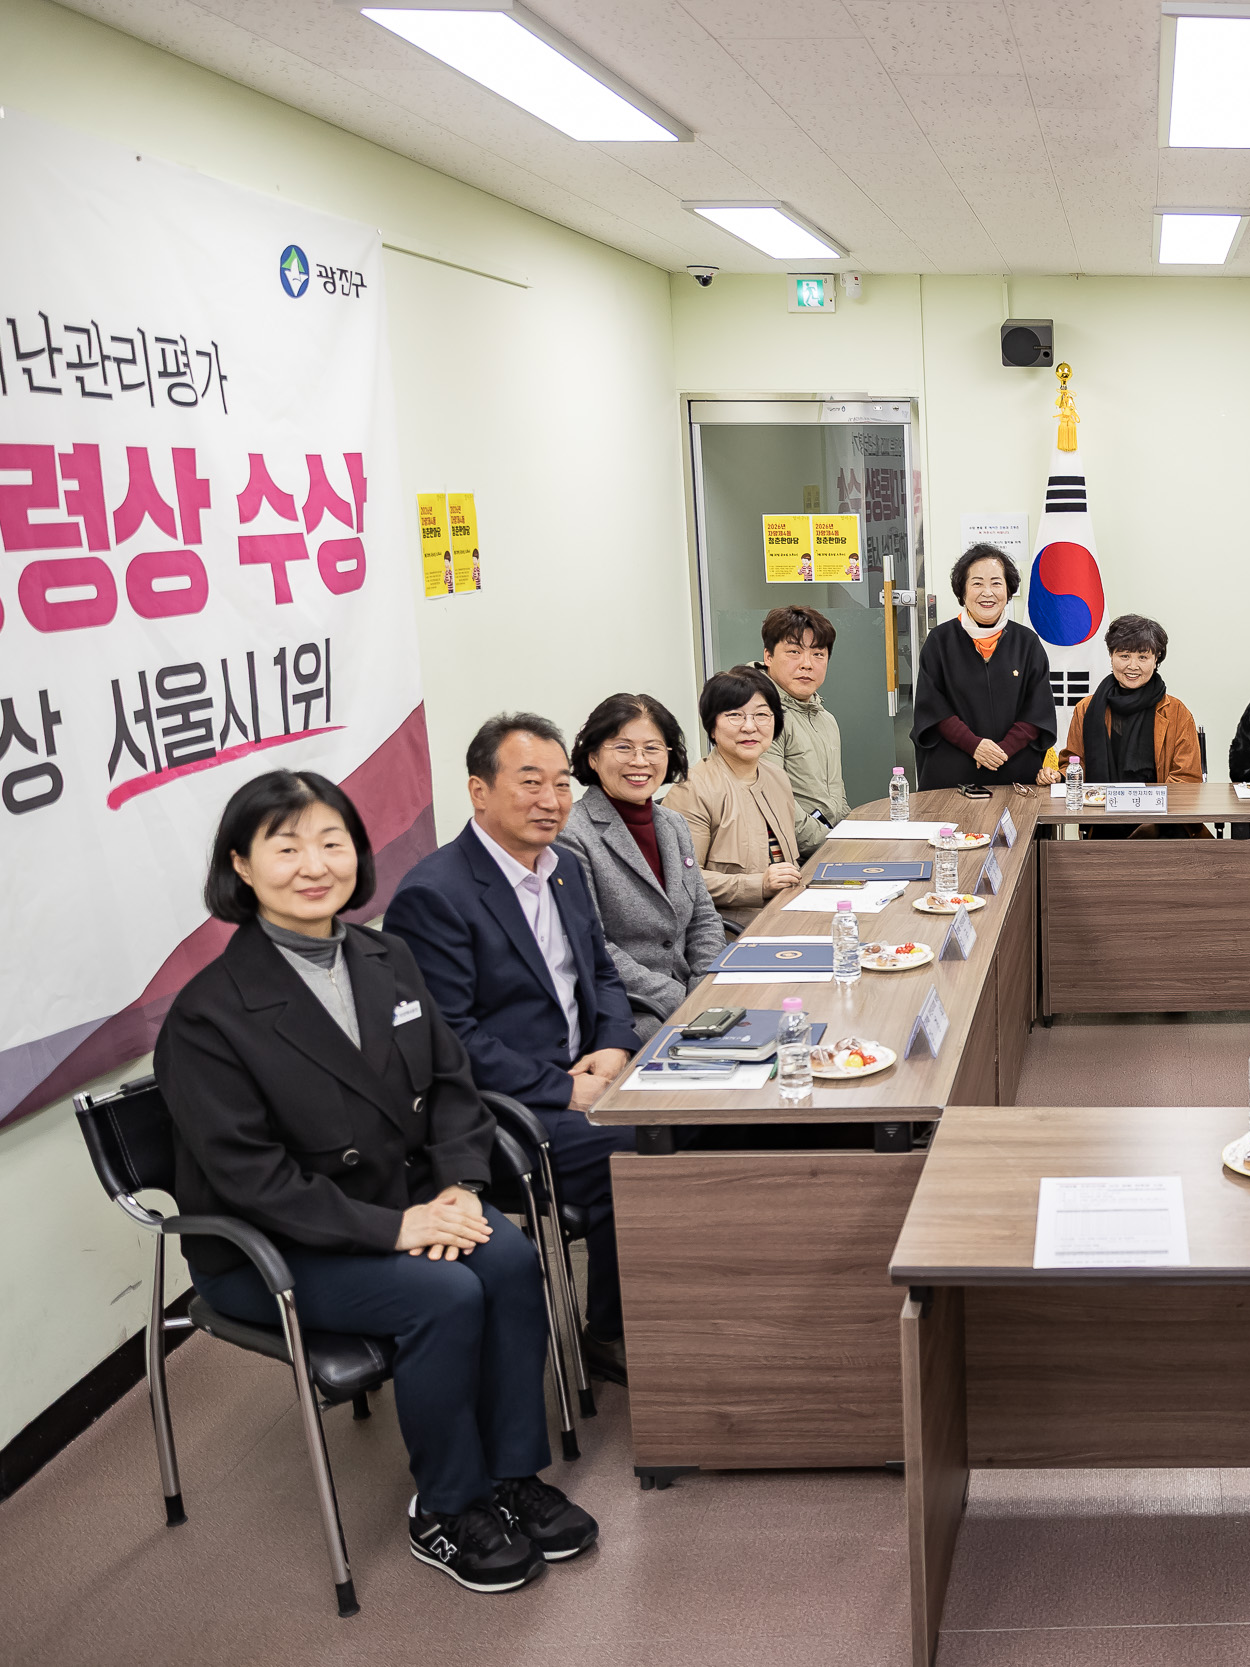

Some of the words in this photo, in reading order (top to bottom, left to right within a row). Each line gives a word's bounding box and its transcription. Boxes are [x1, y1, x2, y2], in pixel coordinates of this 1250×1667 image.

[316, 263, 367, 298] 광진구
[0, 311, 228, 414] 난관리평가
[0, 443, 211, 633] 령상
[237, 453, 367, 605] 수상
[0, 689, 63, 815] 상
[109, 651, 262, 782] 서울시
[274, 637, 332, 731] 1위
